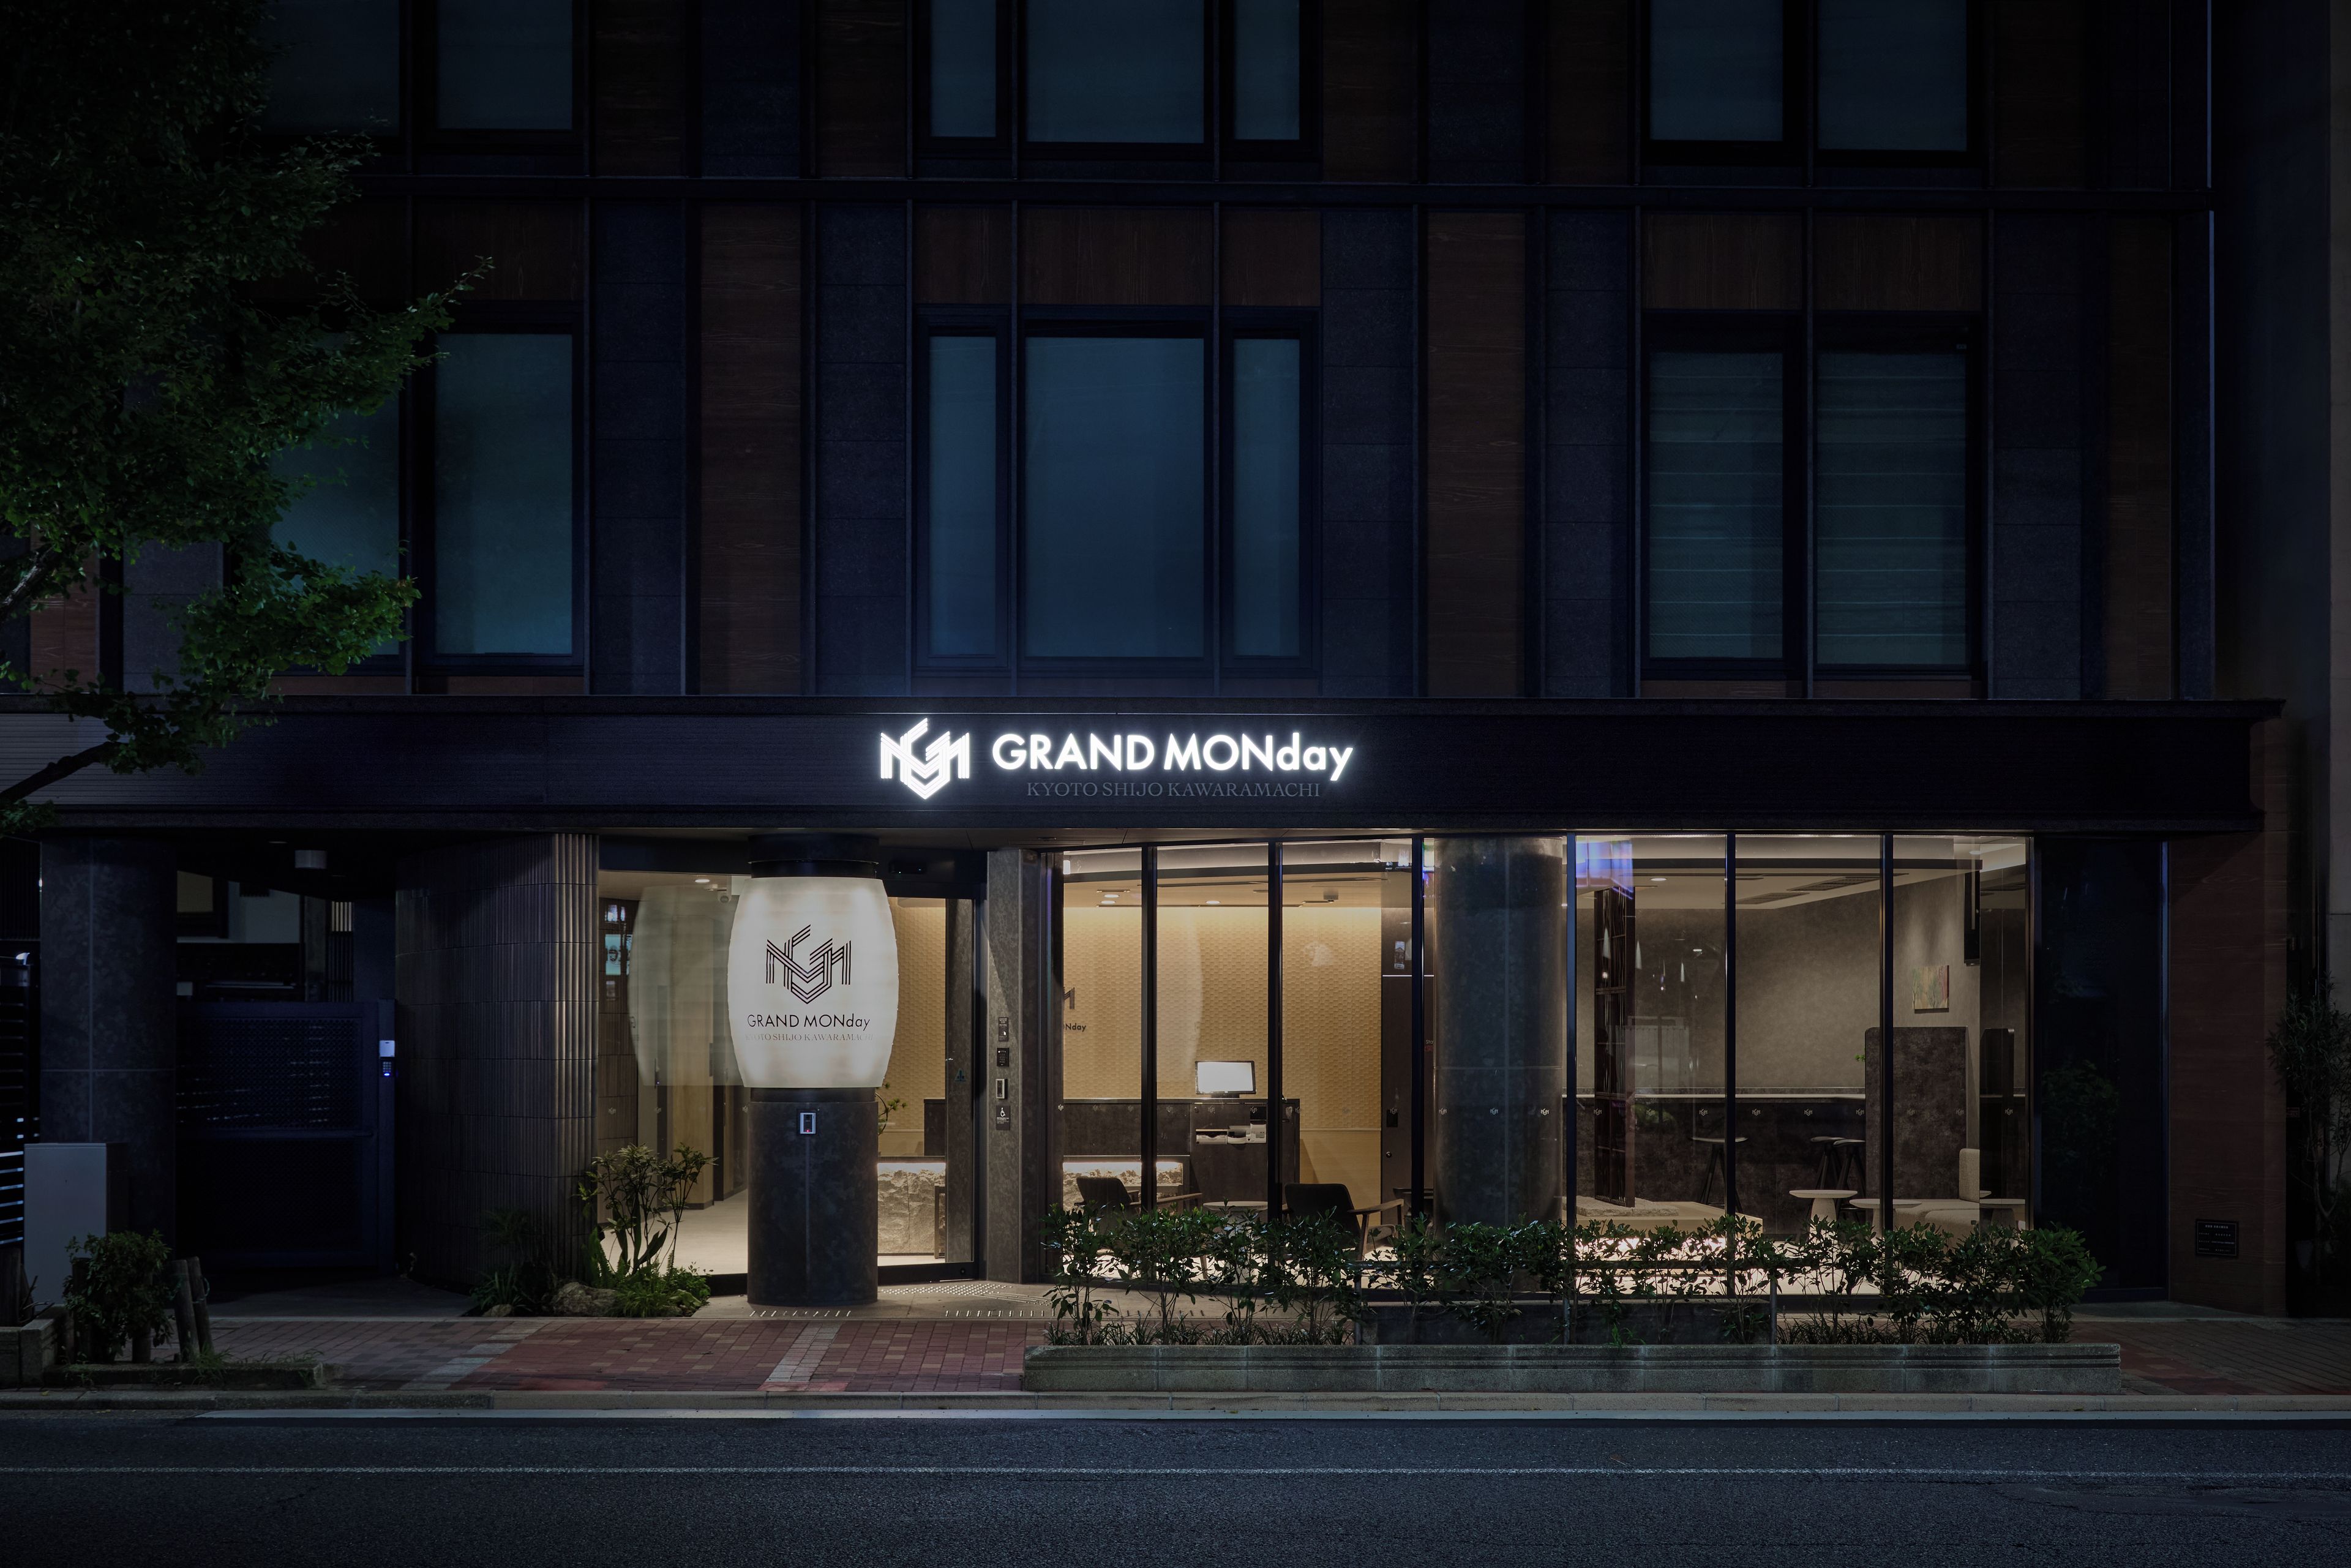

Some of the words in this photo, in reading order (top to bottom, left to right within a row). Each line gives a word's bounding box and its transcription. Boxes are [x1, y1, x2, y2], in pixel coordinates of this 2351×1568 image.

[991, 732, 1155, 771] GRAND
[1163, 732, 1354, 781] MONday
[1027, 782, 1098, 797] KYOTO
[1102, 782, 1163, 797] SHIJO
[1168, 782, 1321, 797] KAWARAMACHI
[747, 1014, 800, 1028] GRAND
[803, 1013, 871, 1032] MONday
[1063, 1022, 1087, 1032] Nday
